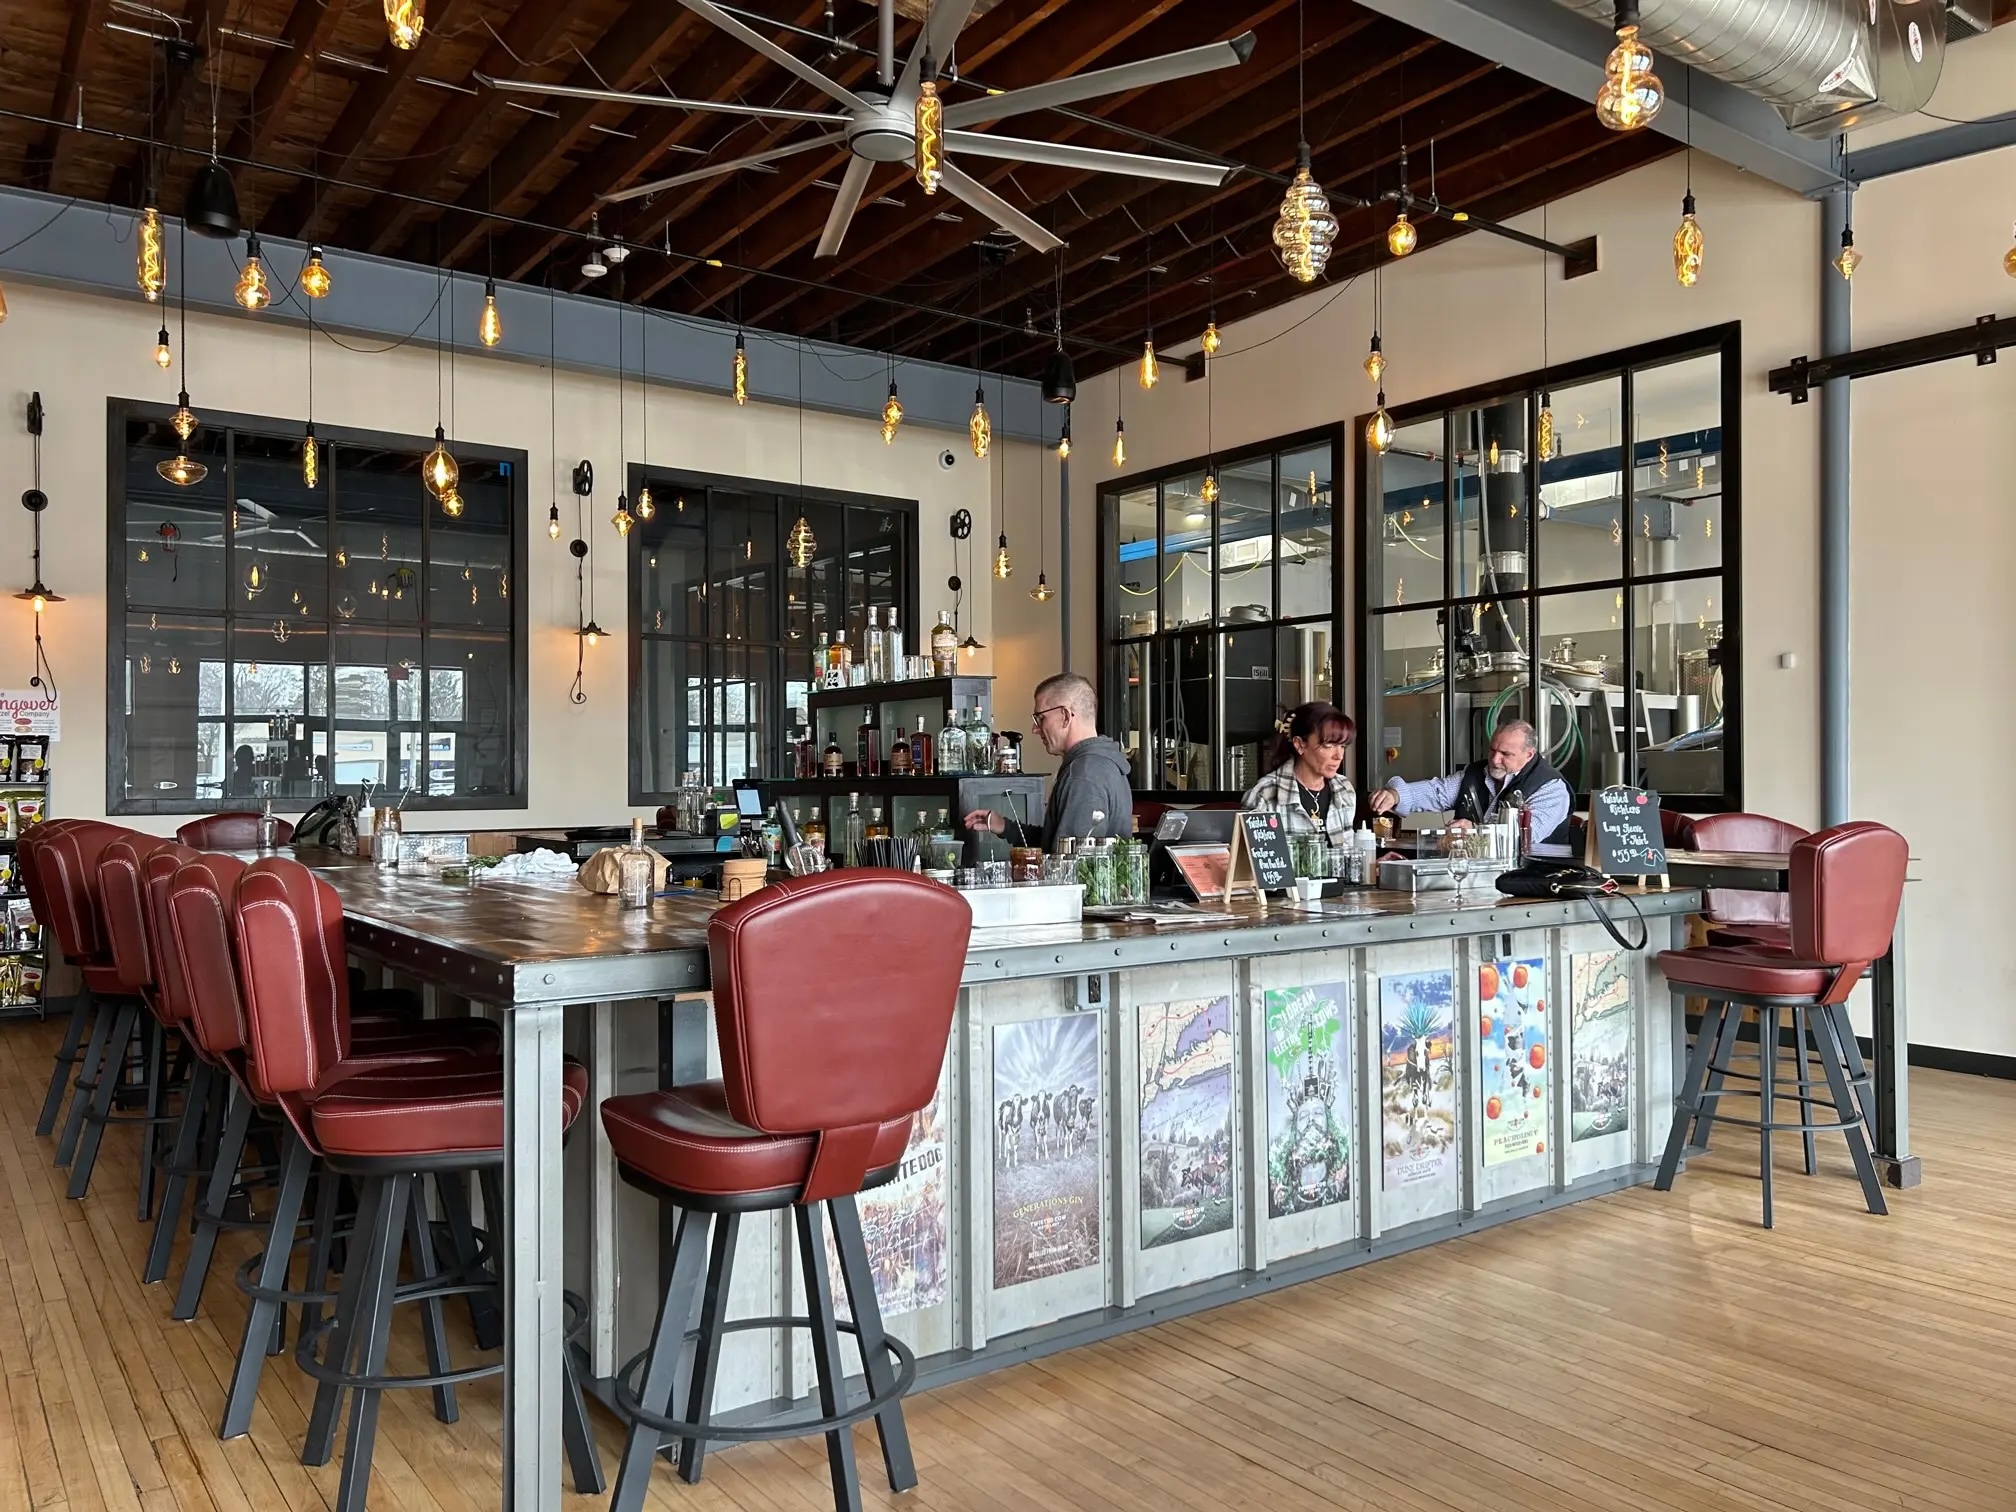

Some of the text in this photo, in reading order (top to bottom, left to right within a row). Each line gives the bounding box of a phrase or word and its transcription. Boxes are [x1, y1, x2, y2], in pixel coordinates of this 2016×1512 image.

[1600, 791, 1629, 804] Twisted
[1603, 822, 1644, 837] Long Sleeve
[1621, 834, 1649, 845] T-Shirt
[1286, 988, 1316, 1020] DREAM
[1314, 1000, 1338, 1027] COWS
[1013, 1195, 1084, 1218] GENERATIONS GIN
